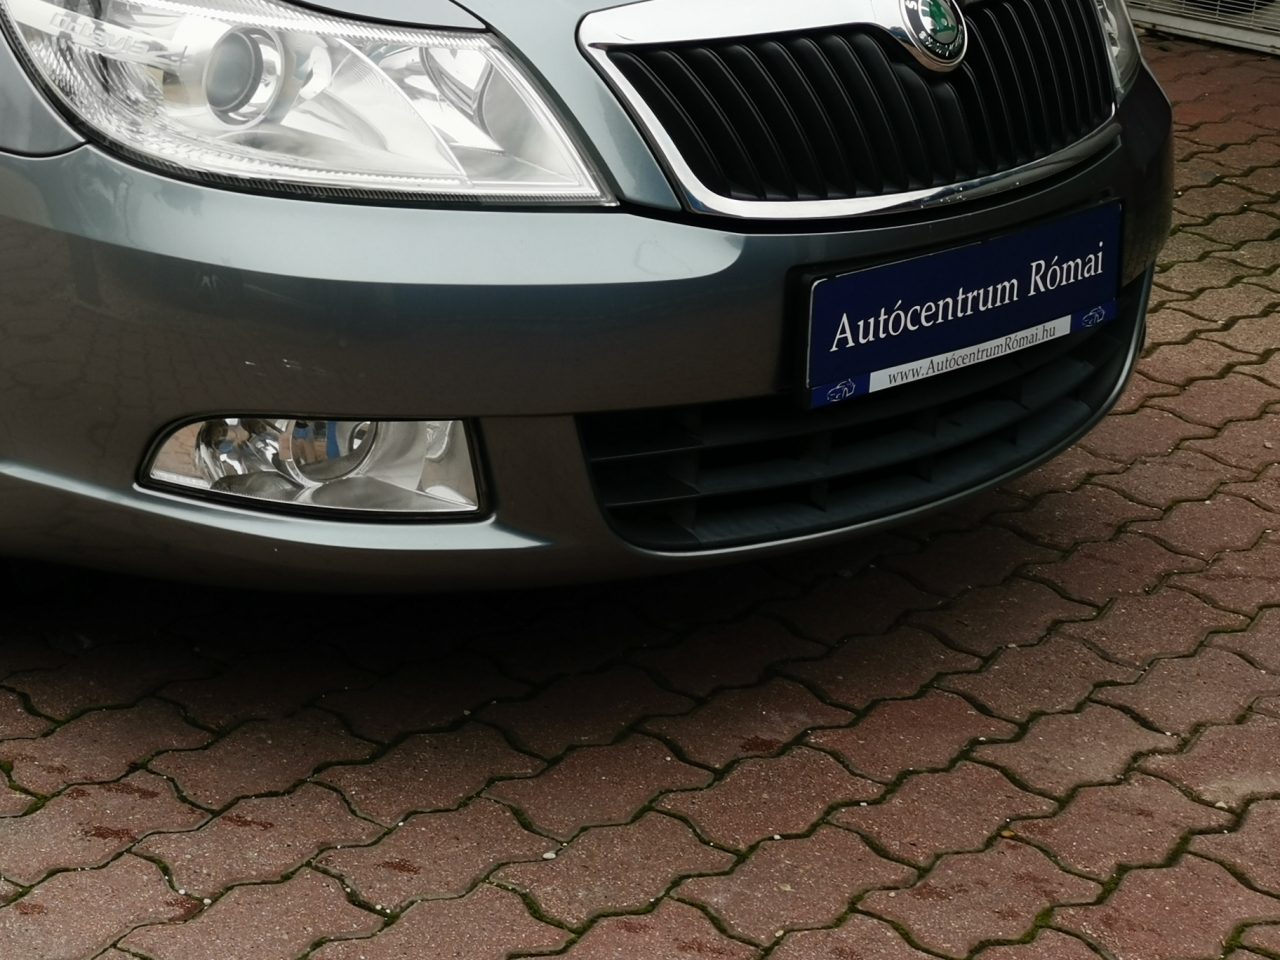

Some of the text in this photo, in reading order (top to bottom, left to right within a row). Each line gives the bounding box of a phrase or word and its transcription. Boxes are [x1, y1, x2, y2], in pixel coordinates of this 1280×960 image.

[829, 241, 1104, 352] Autócentrum Római
[888, 325, 1056, 385] www.AutócentrumRómai.hu
